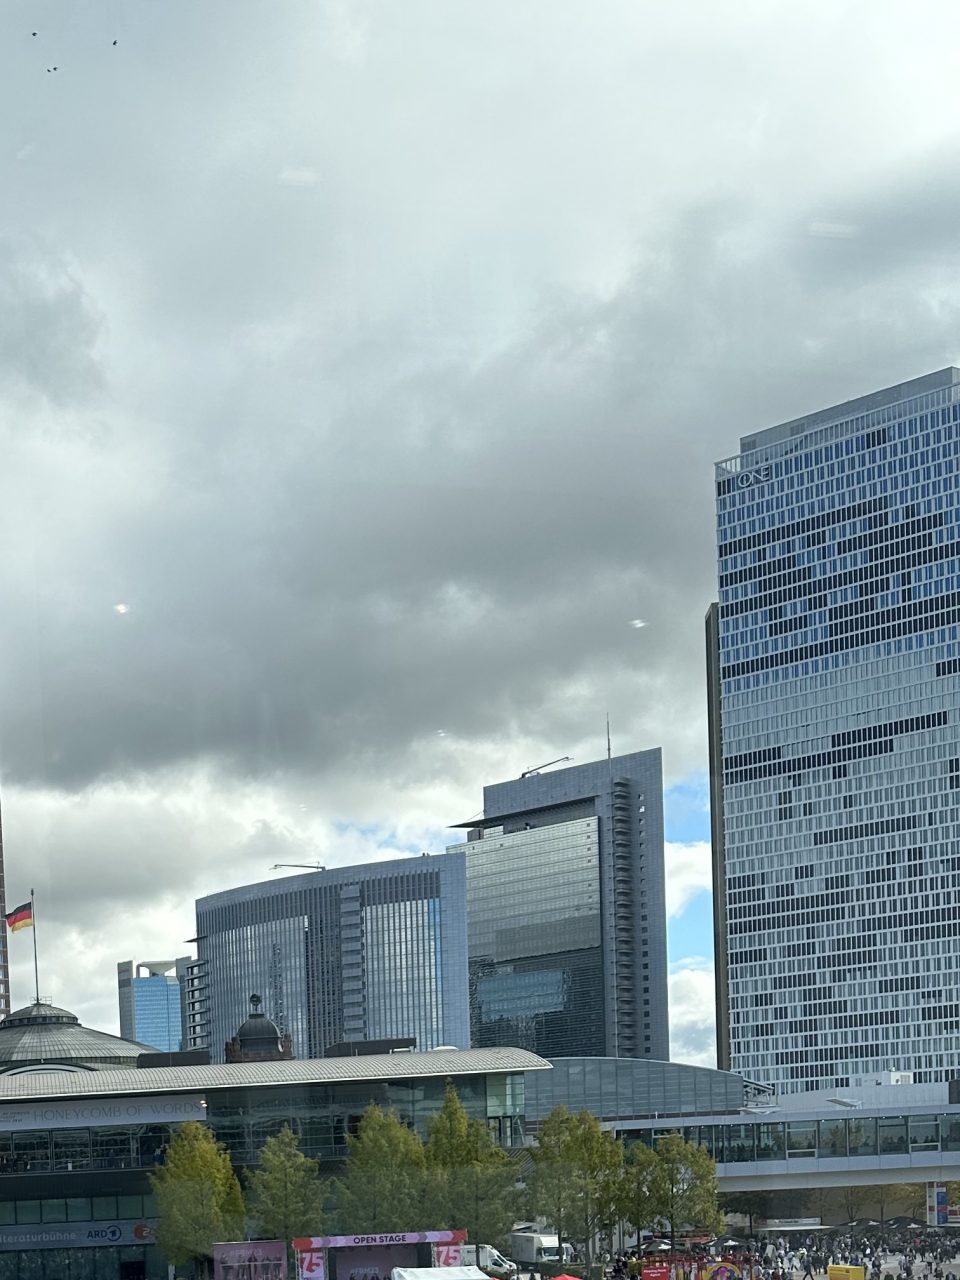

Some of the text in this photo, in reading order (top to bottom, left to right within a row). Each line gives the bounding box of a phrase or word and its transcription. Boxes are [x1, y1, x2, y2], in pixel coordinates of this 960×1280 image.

[738, 465, 770, 487] ONE
[34, 1106, 121, 1121] HONEYCOMB
[126, 1105, 142, 1116] OF
[150, 1102, 202, 1115] WORDS
[87, 1229, 108, 1239] ARD
[353, 1234, 407, 1244] OPEN STAGE
